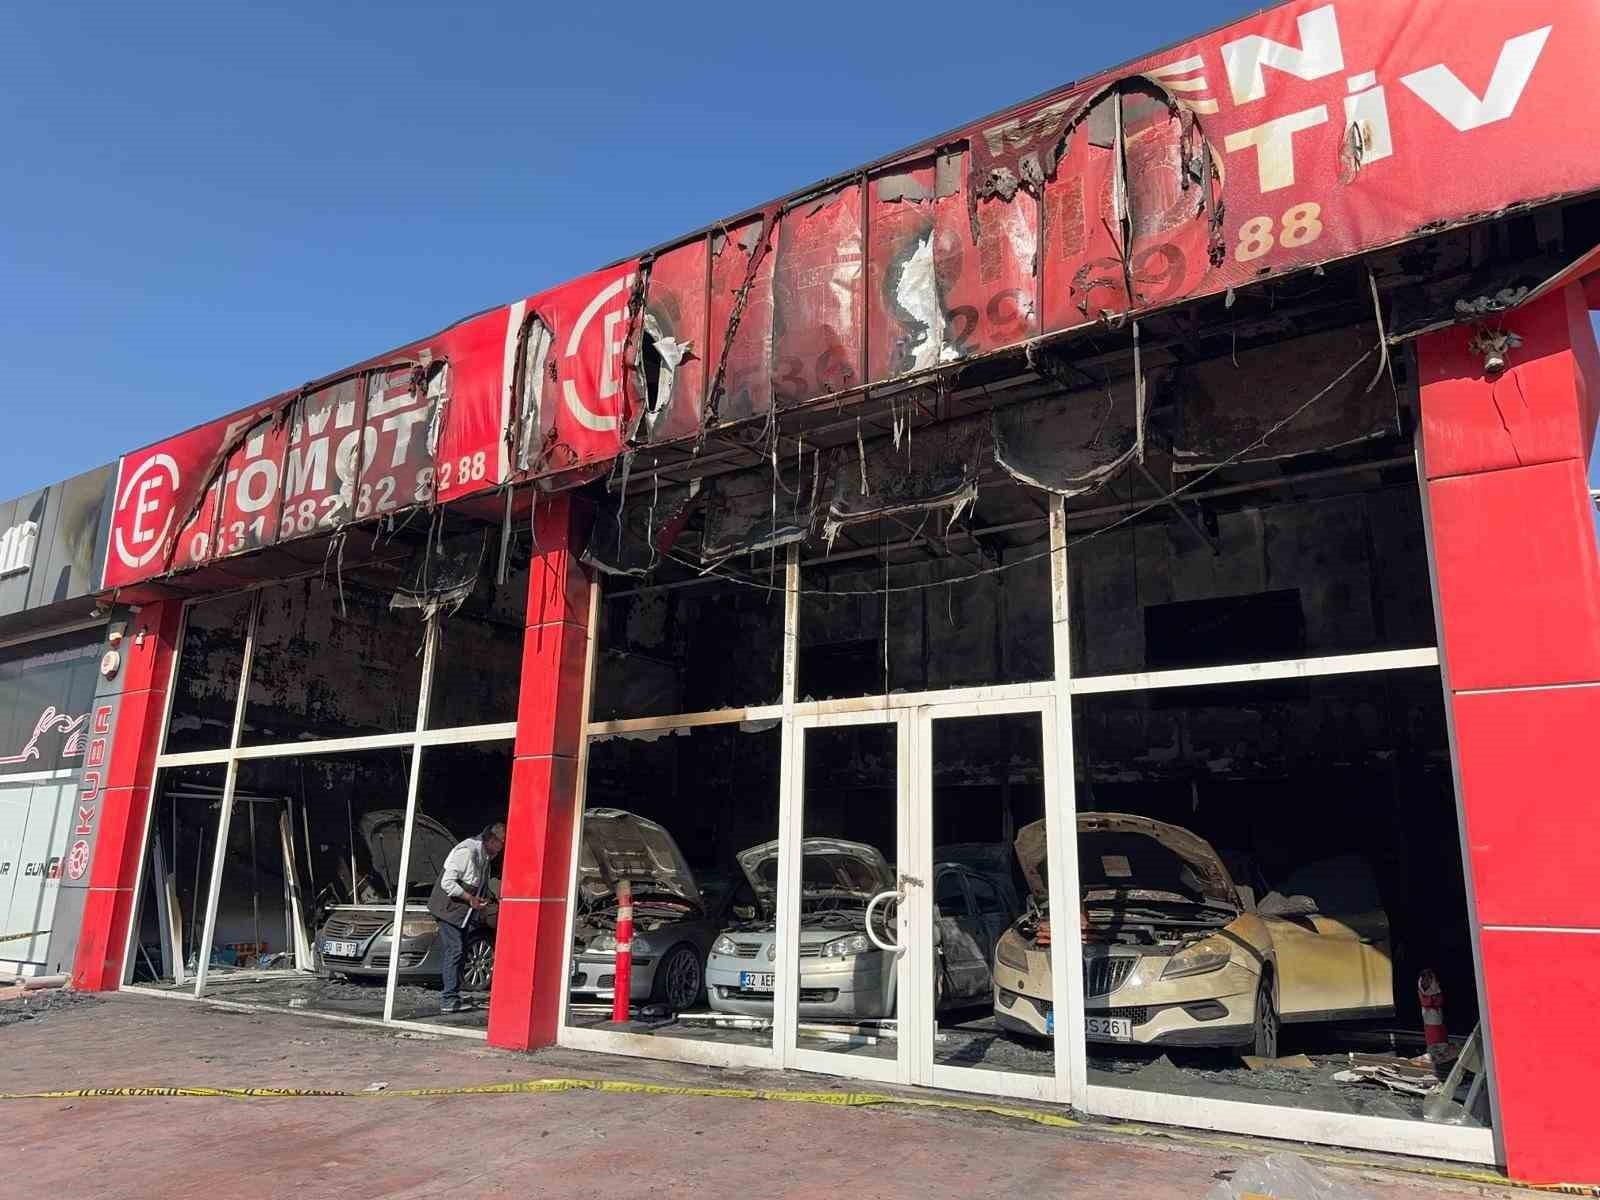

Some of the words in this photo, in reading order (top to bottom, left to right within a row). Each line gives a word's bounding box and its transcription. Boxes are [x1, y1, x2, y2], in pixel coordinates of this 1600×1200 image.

[1233, 201, 1324, 263] 88
[458, 451, 486, 485] 88
[76, 704, 113, 836] KUBA
